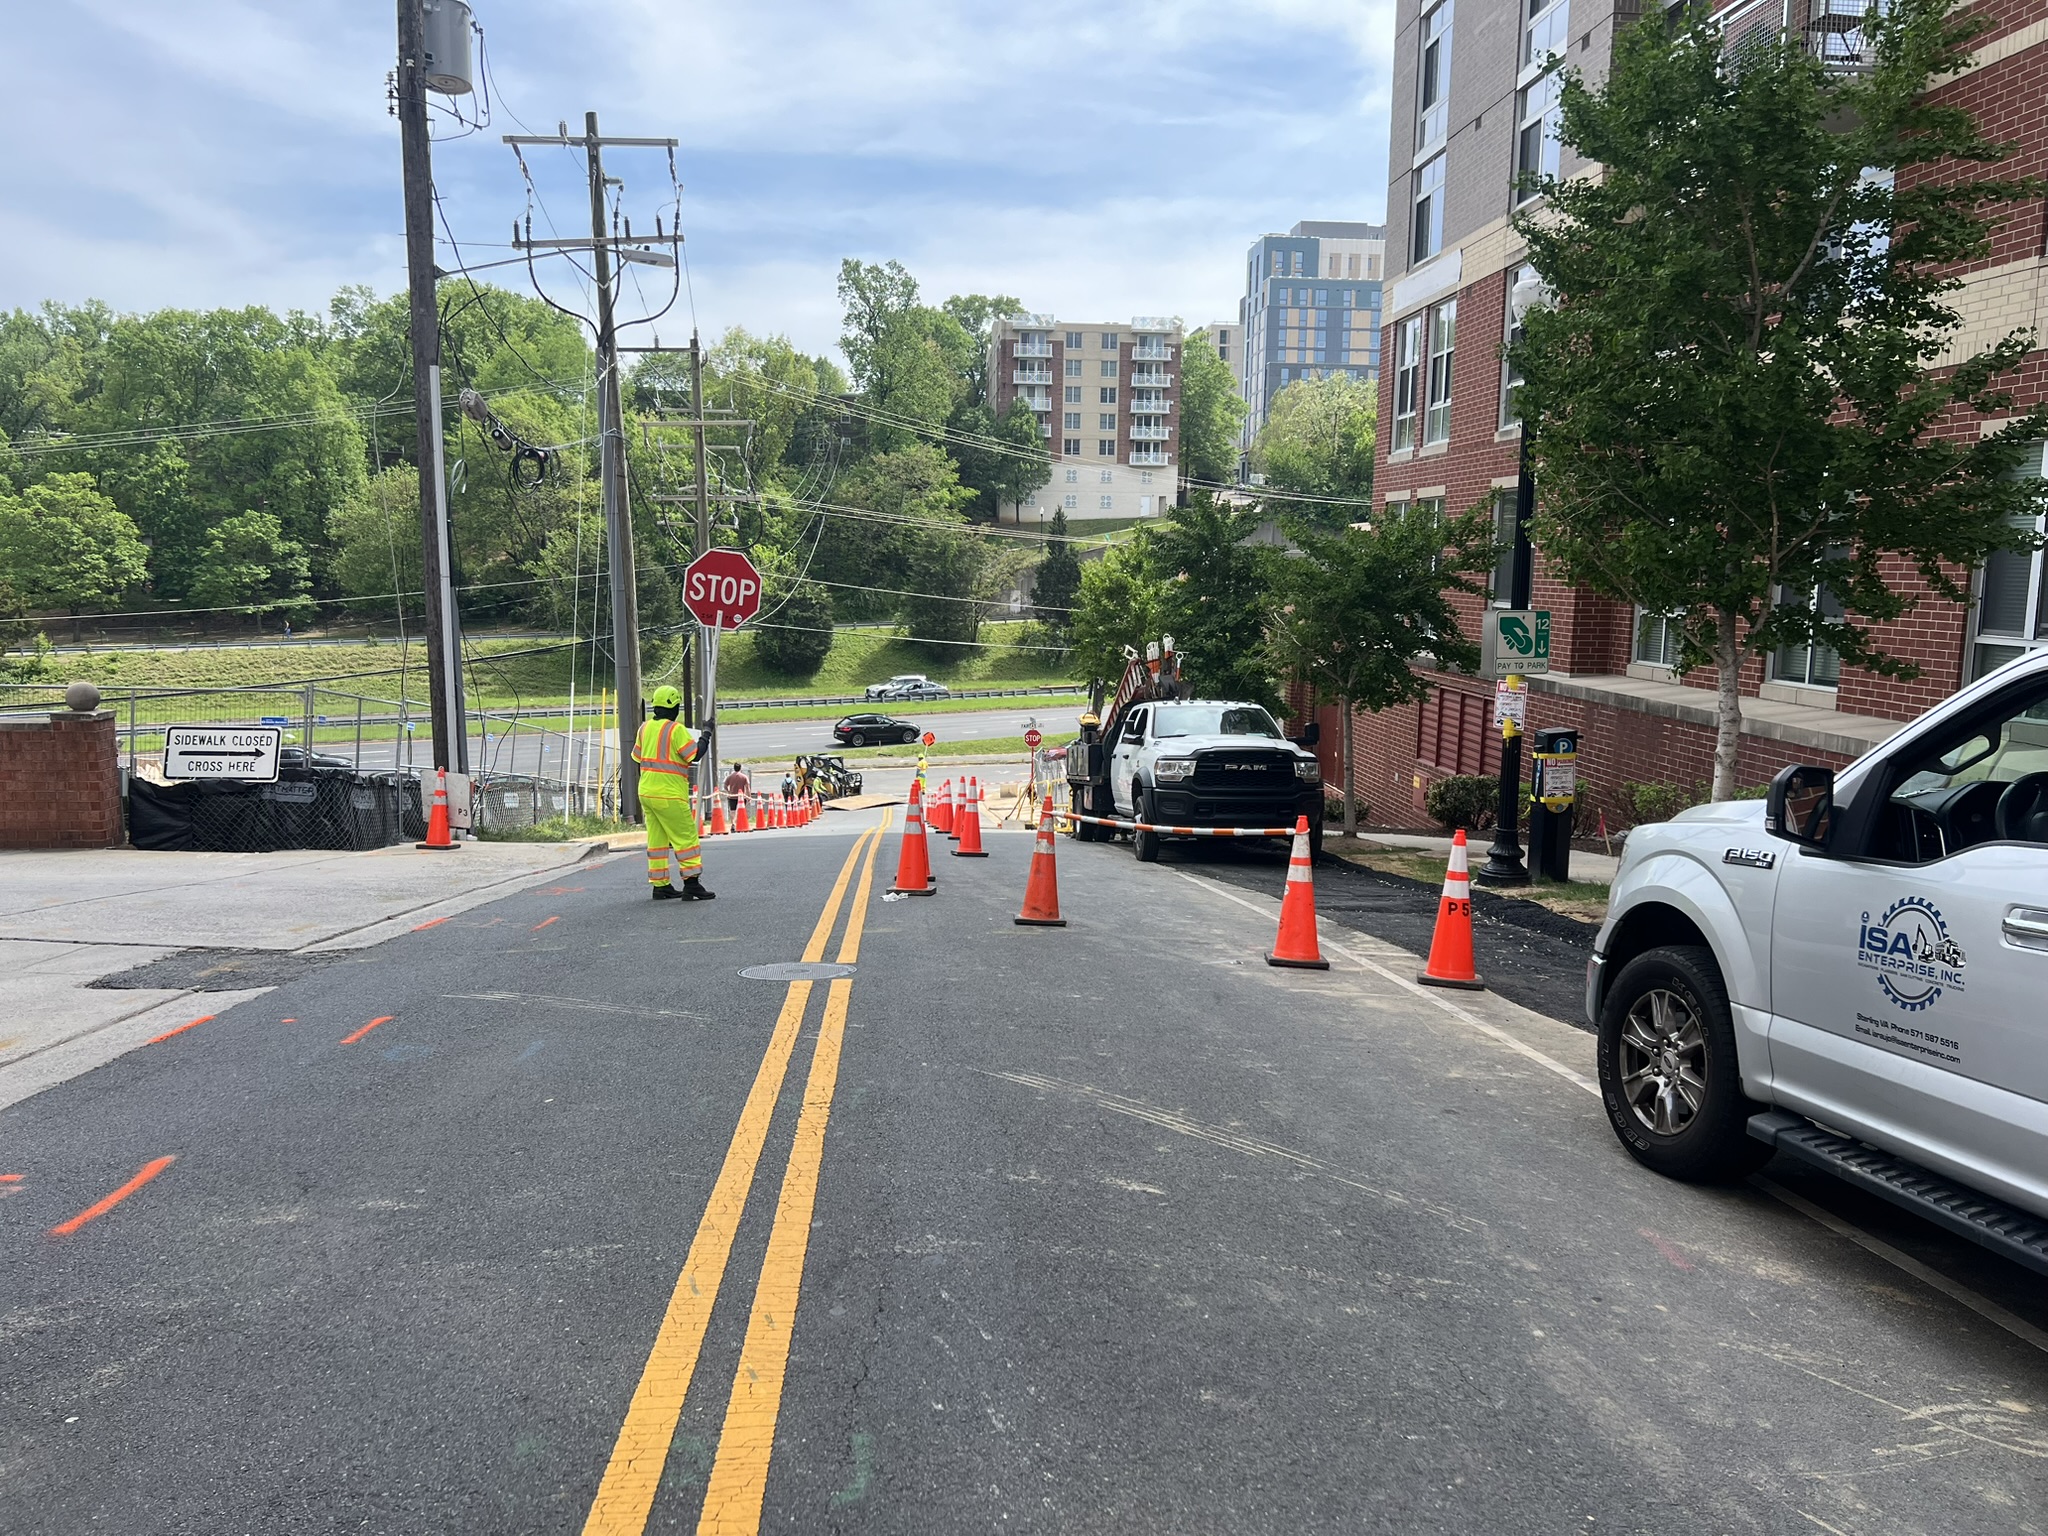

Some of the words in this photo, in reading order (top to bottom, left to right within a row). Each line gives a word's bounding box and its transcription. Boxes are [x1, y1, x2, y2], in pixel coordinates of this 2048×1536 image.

[689, 572, 756, 606] STOP
[1536, 619, 1550, 630] 12
[1497, 662, 1511, 670] PAY
[1514, 662, 1524, 670] TO
[1527, 661, 1546, 669] PARK
[174, 735, 226, 746] SIDEWALK
[232, 735, 273, 747] CLOSED
[1025, 734, 1041, 742] STOP
[1559, 741, 1568, 754] P
[188, 761, 223, 772] CROSS
[228, 761, 256, 772] HERE
[1546, 758, 1557, 766] NO
[1858, 950, 1938, 980] ENTERPRISE,
[1940, 969, 1965, 985] INC.
[1910, 1028, 1923, 1039] 571
[1925, 1033, 1939, 1043] 587
[1940, 1037, 1959, 1050] 5516
